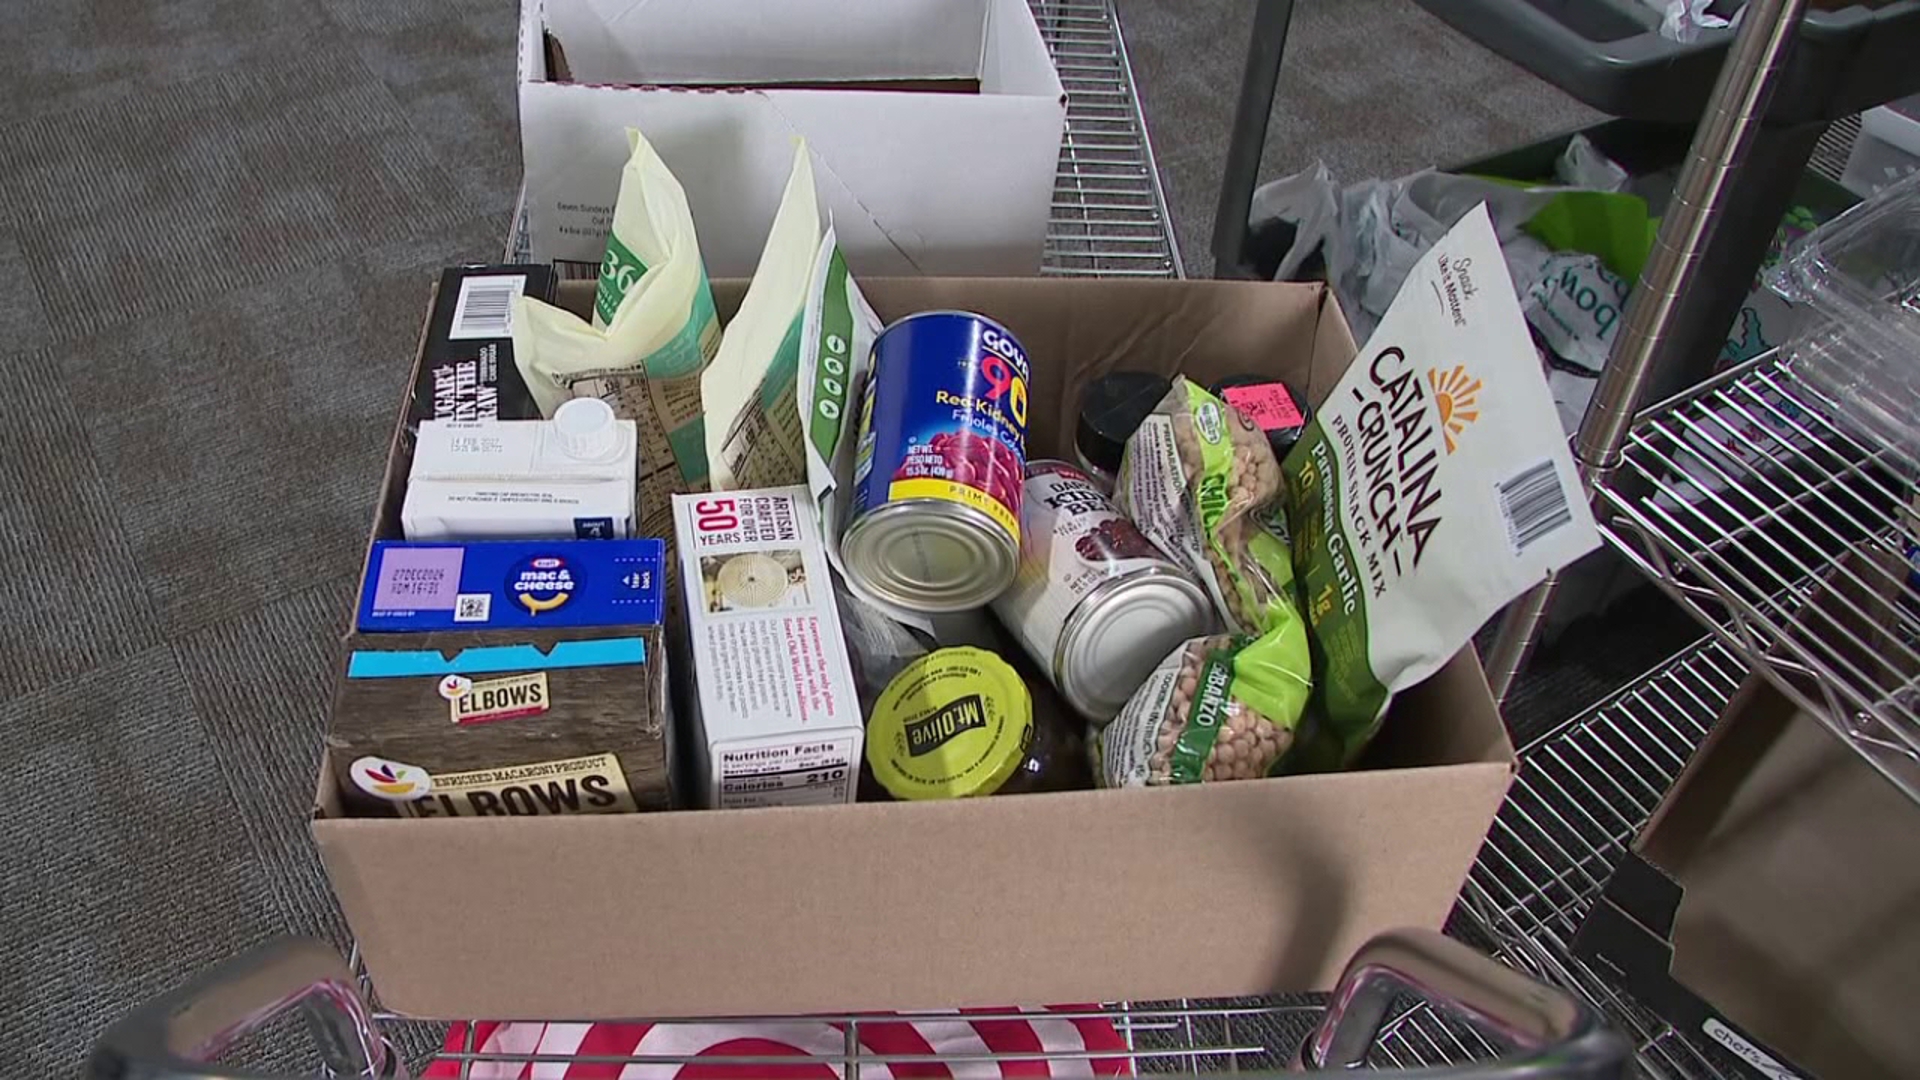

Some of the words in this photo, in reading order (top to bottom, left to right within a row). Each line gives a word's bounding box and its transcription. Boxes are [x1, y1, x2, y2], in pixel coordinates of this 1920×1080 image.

[982, 329, 1030, 383] GOYA
[456, 361, 476, 399] THE
[434, 375, 455, 420] UGAR
[456, 400, 476, 420] IN
[477, 384, 498, 420] RAW
[936, 390, 971, 409] Red
[974, 396, 1021, 441] Kidney
[1369, 345, 1442, 572] CATALINA
[696, 499, 738, 532] 50
[739, 498, 753, 517] FOR
[754, 497, 776, 541] CRAFTED
[772, 496, 795, 541] ARTISAN
[1332, 413, 1357, 475] PROTEIN
[1347, 480, 1372, 548] SNACK
[1366, 553, 1387, 598] MIX
[699, 532, 741, 546] YEARS
[742, 519, 759, 542] OVER
[1311, 440, 1336, 533] Parmesan
[1326, 532, 1359, 616] Garlic
[520, 570, 556, 581] mac
[787, 639, 795, 655] Old
[790, 655, 801, 682] World
[460, 683, 542, 714] ELBOWS
[953, 699, 981, 725] Mt.
[912, 711, 956, 745] Olive
[723, 747, 789, 762] Nutrition
[794, 743, 835, 755] Facts
[433, 771, 493, 787] ENRICHED
[493, 765, 554, 782] MACARONI
[556, 757, 607, 774] PRODUCT
[723, 781, 784, 792] Calories
[806, 769, 844, 784] 210
[1713, 1026, 1760, 1064] chef's
